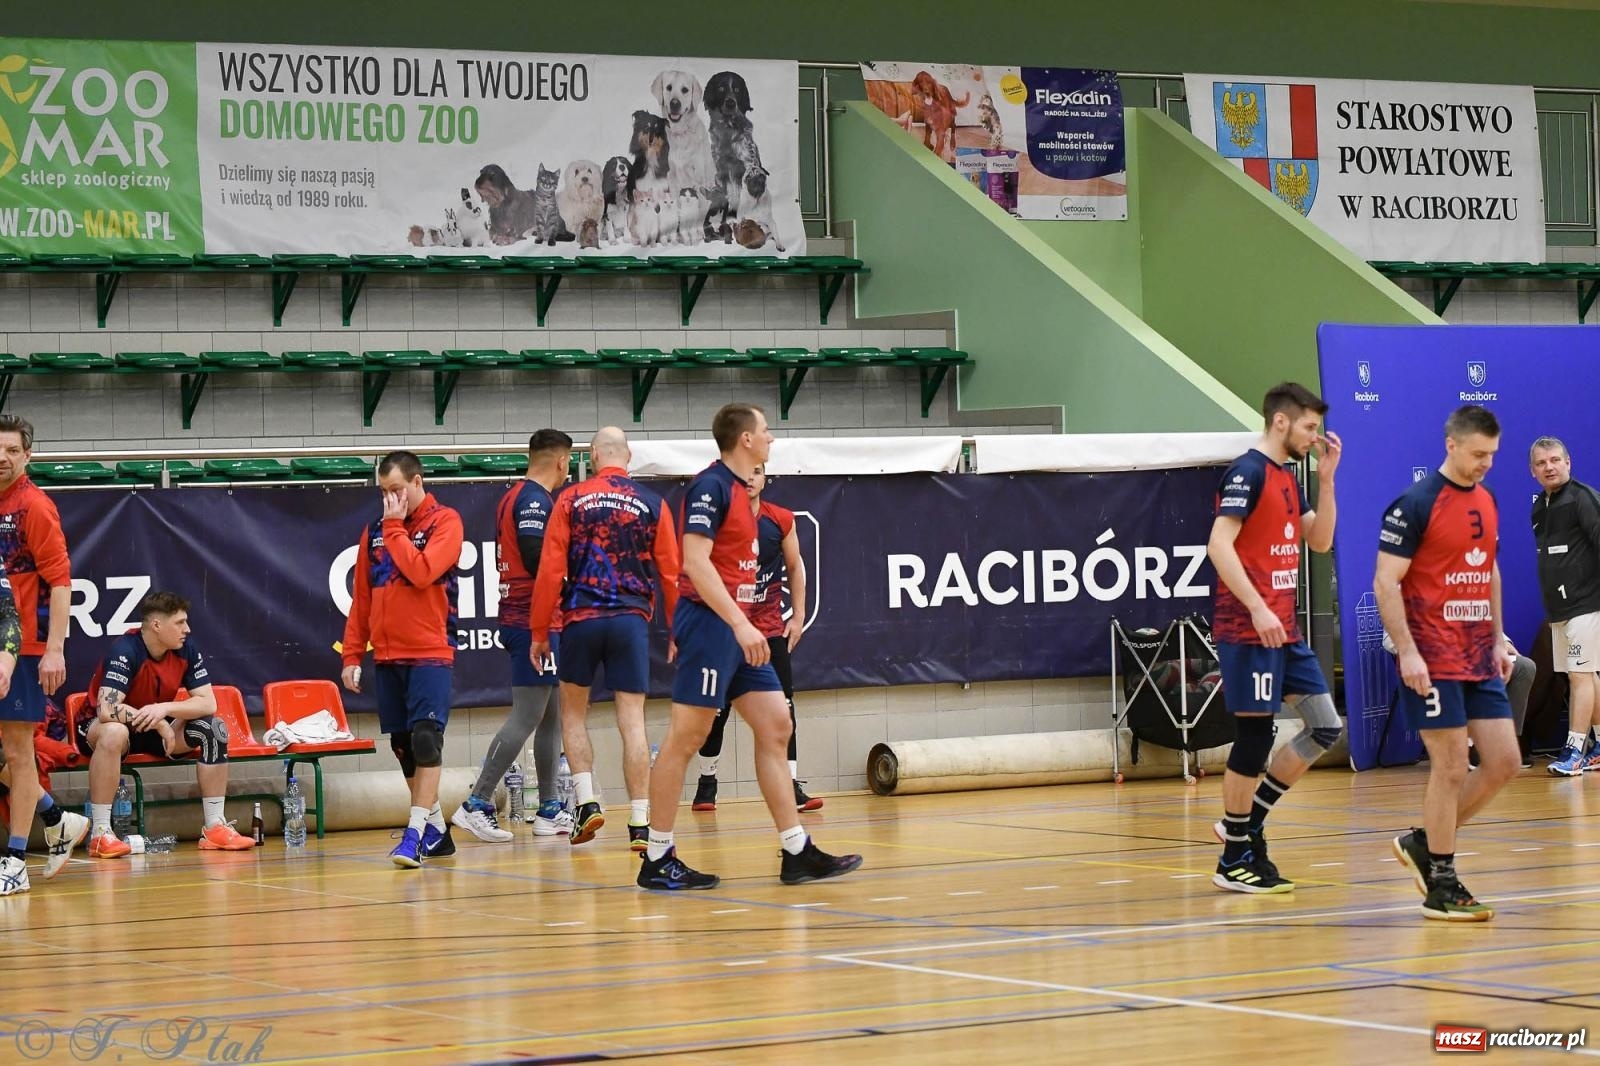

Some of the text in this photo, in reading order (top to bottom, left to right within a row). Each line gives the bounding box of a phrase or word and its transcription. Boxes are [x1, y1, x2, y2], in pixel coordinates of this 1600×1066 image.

[219, 51, 589, 101] WSZYSTKO DLA TWOJEGO
[28, 65, 169, 118] ZOO
[1035, 89, 1112, 106] Flexadin
[220, 99, 479, 144] DOMOWEGO ZOO
[1336, 101, 1513, 133] STAROSTWO
[20, 117, 170, 168] MAR
[1039, 141, 1114, 150] mobilności stawów
[1056, 131, 1094, 141] Wsparcie
[1053, 153, 1074, 163] psów
[1081, 153, 1107, 162] kotów
[1338, 145, 1512, 177] POWIATOWE
[21, 170, 171, 191] sklep zoologiczny
[219, 164, 375, 188] Dzielimy się naszą pasją
[221, 189, 367, 209] i wiedzą od 1989 roku.
[1338, 195, 1518, 221] W RACIBORZU
[1459, 391, 1497, 401] Racibórz
[1468, 510, 1484, 540] 3
[887, 527, 1210, 608] RACIBÓRZ
[1558, 584, 1567, 599] 1
[701, 667, 718, 697] 11
[1252, 672, 1273, 701] 10
[1425, 687, 1442, 717] 3
